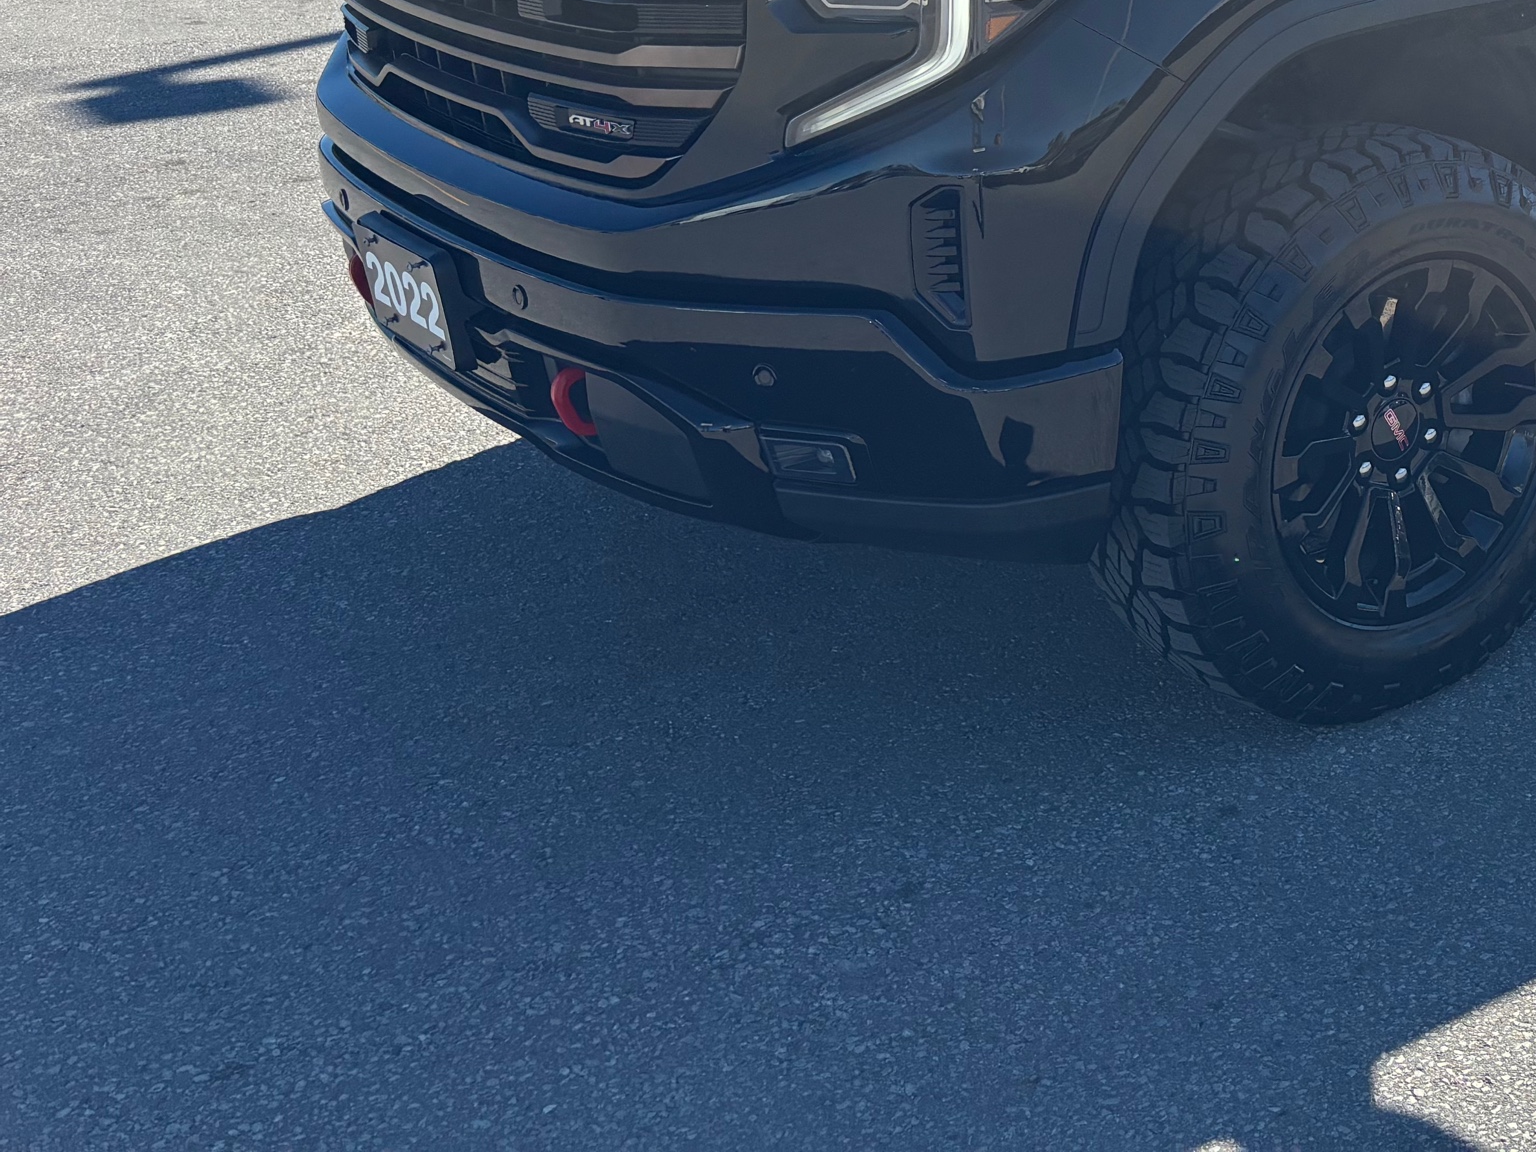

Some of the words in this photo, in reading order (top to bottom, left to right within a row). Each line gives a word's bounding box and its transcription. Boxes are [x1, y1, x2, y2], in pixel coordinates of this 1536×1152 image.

[568, 114, 631, 135] AT4X
[365, 251, 446, 342] 2022
[1383, 408, 1409, 452] GMC
